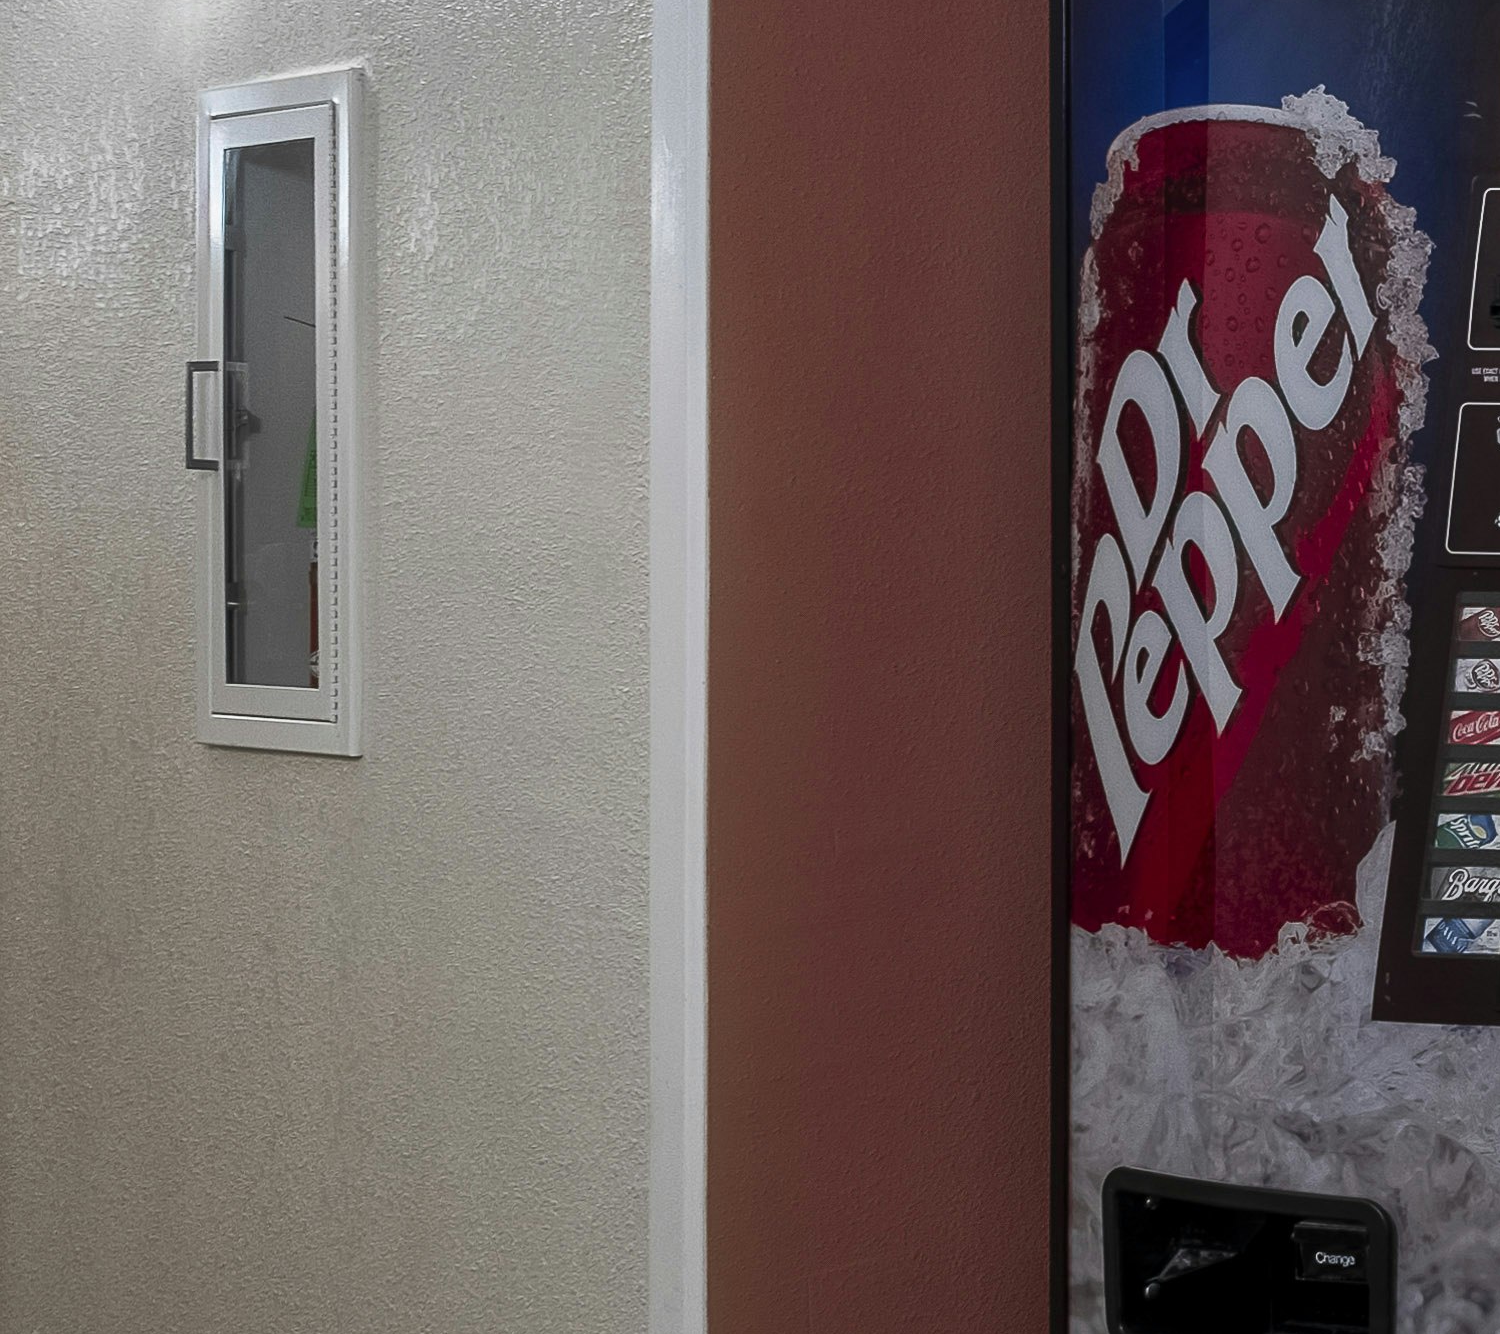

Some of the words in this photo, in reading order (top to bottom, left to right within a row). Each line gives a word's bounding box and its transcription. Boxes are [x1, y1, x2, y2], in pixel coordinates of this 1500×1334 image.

[1075, 193, 1377, 870] Pepper
[1097, 278, 1221, 594] Dr
[1315, 1251, 1355, 1267] Change
